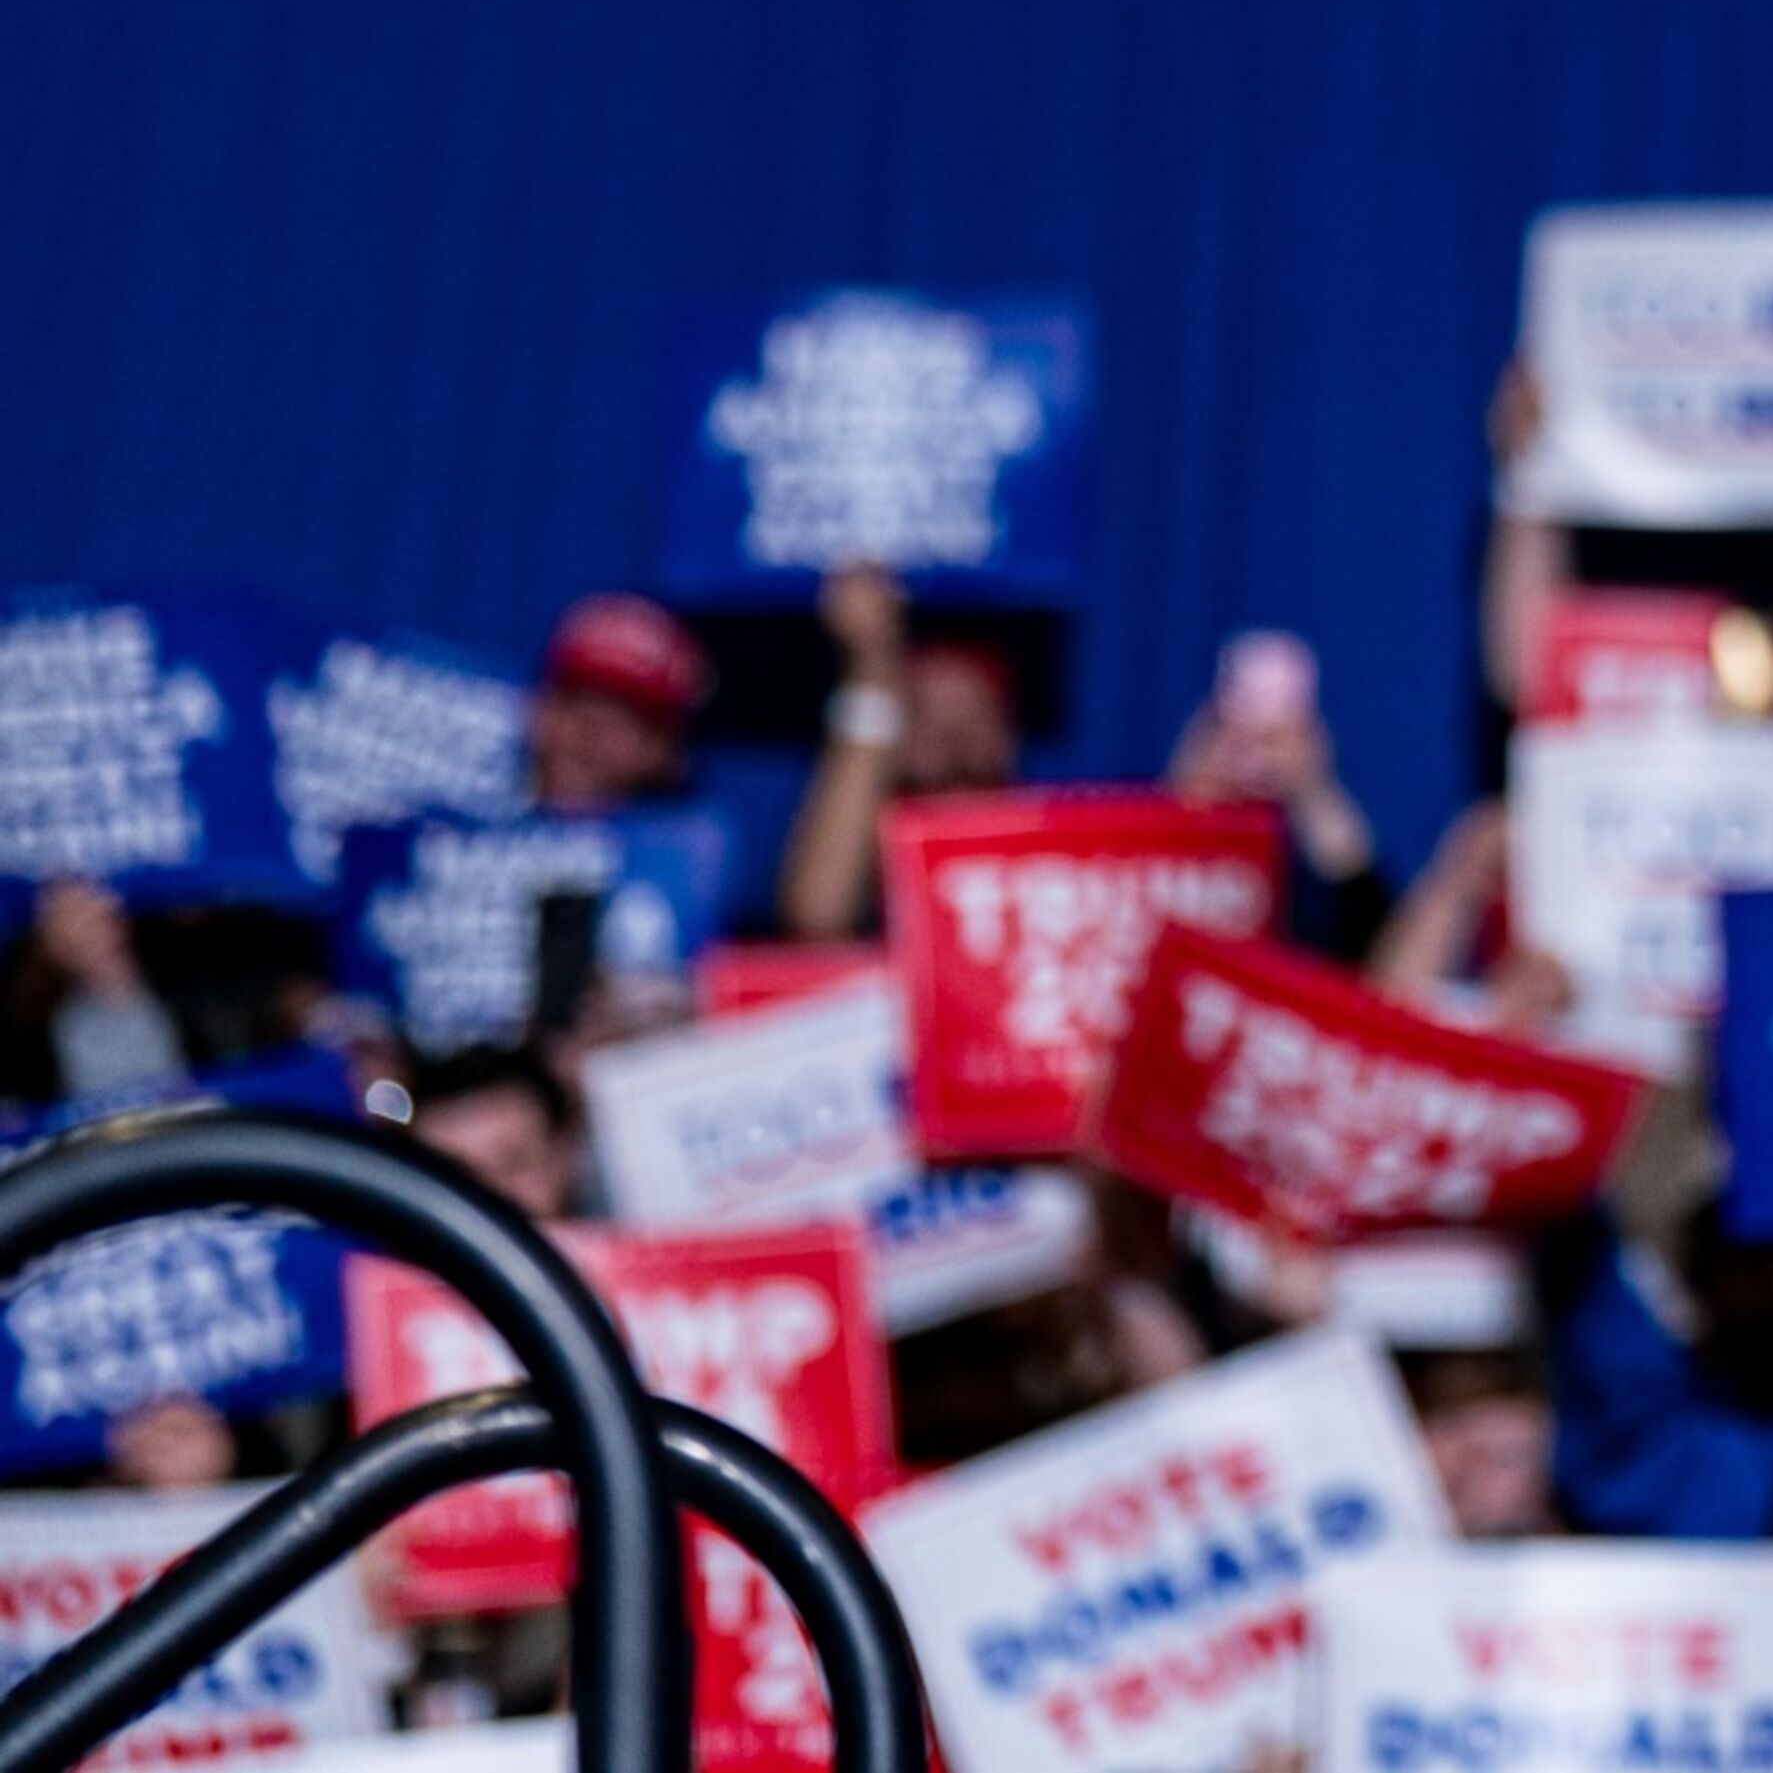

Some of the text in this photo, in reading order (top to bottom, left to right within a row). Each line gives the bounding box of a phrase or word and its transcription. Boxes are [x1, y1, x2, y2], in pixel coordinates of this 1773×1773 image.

[1014, 1442, 1272, 1580] VOTE
[968, 1480, 1386, 1696] DONALD
[1452, 1612, 1736, 1690] VOTE
[1040, 1600, 1312, 1752] TRUM
